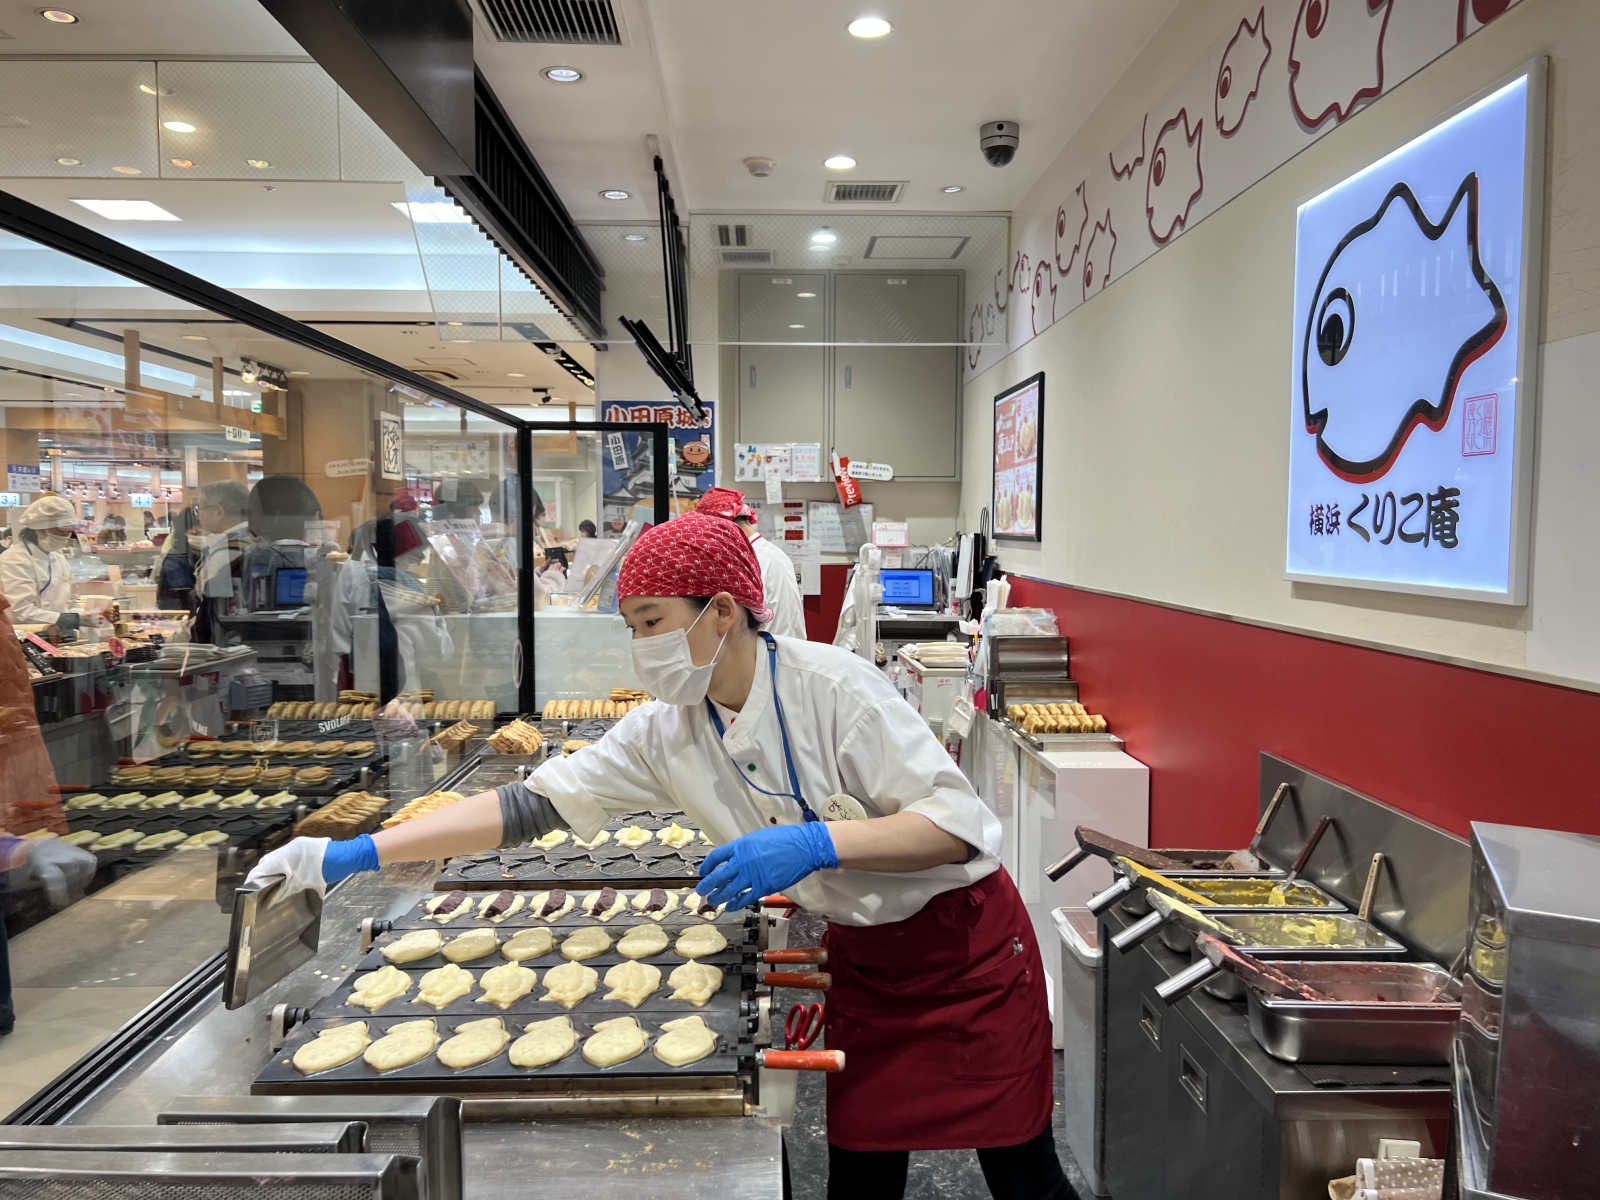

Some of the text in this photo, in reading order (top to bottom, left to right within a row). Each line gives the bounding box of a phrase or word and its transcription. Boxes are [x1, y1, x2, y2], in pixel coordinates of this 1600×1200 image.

[840, 467, 858, 505] Preview
[134, 495, 142, 506] 4
[1309, 485, 1461, 549] 横浜 くりこ庵
[318, 714, 351, 733] SVOLME
